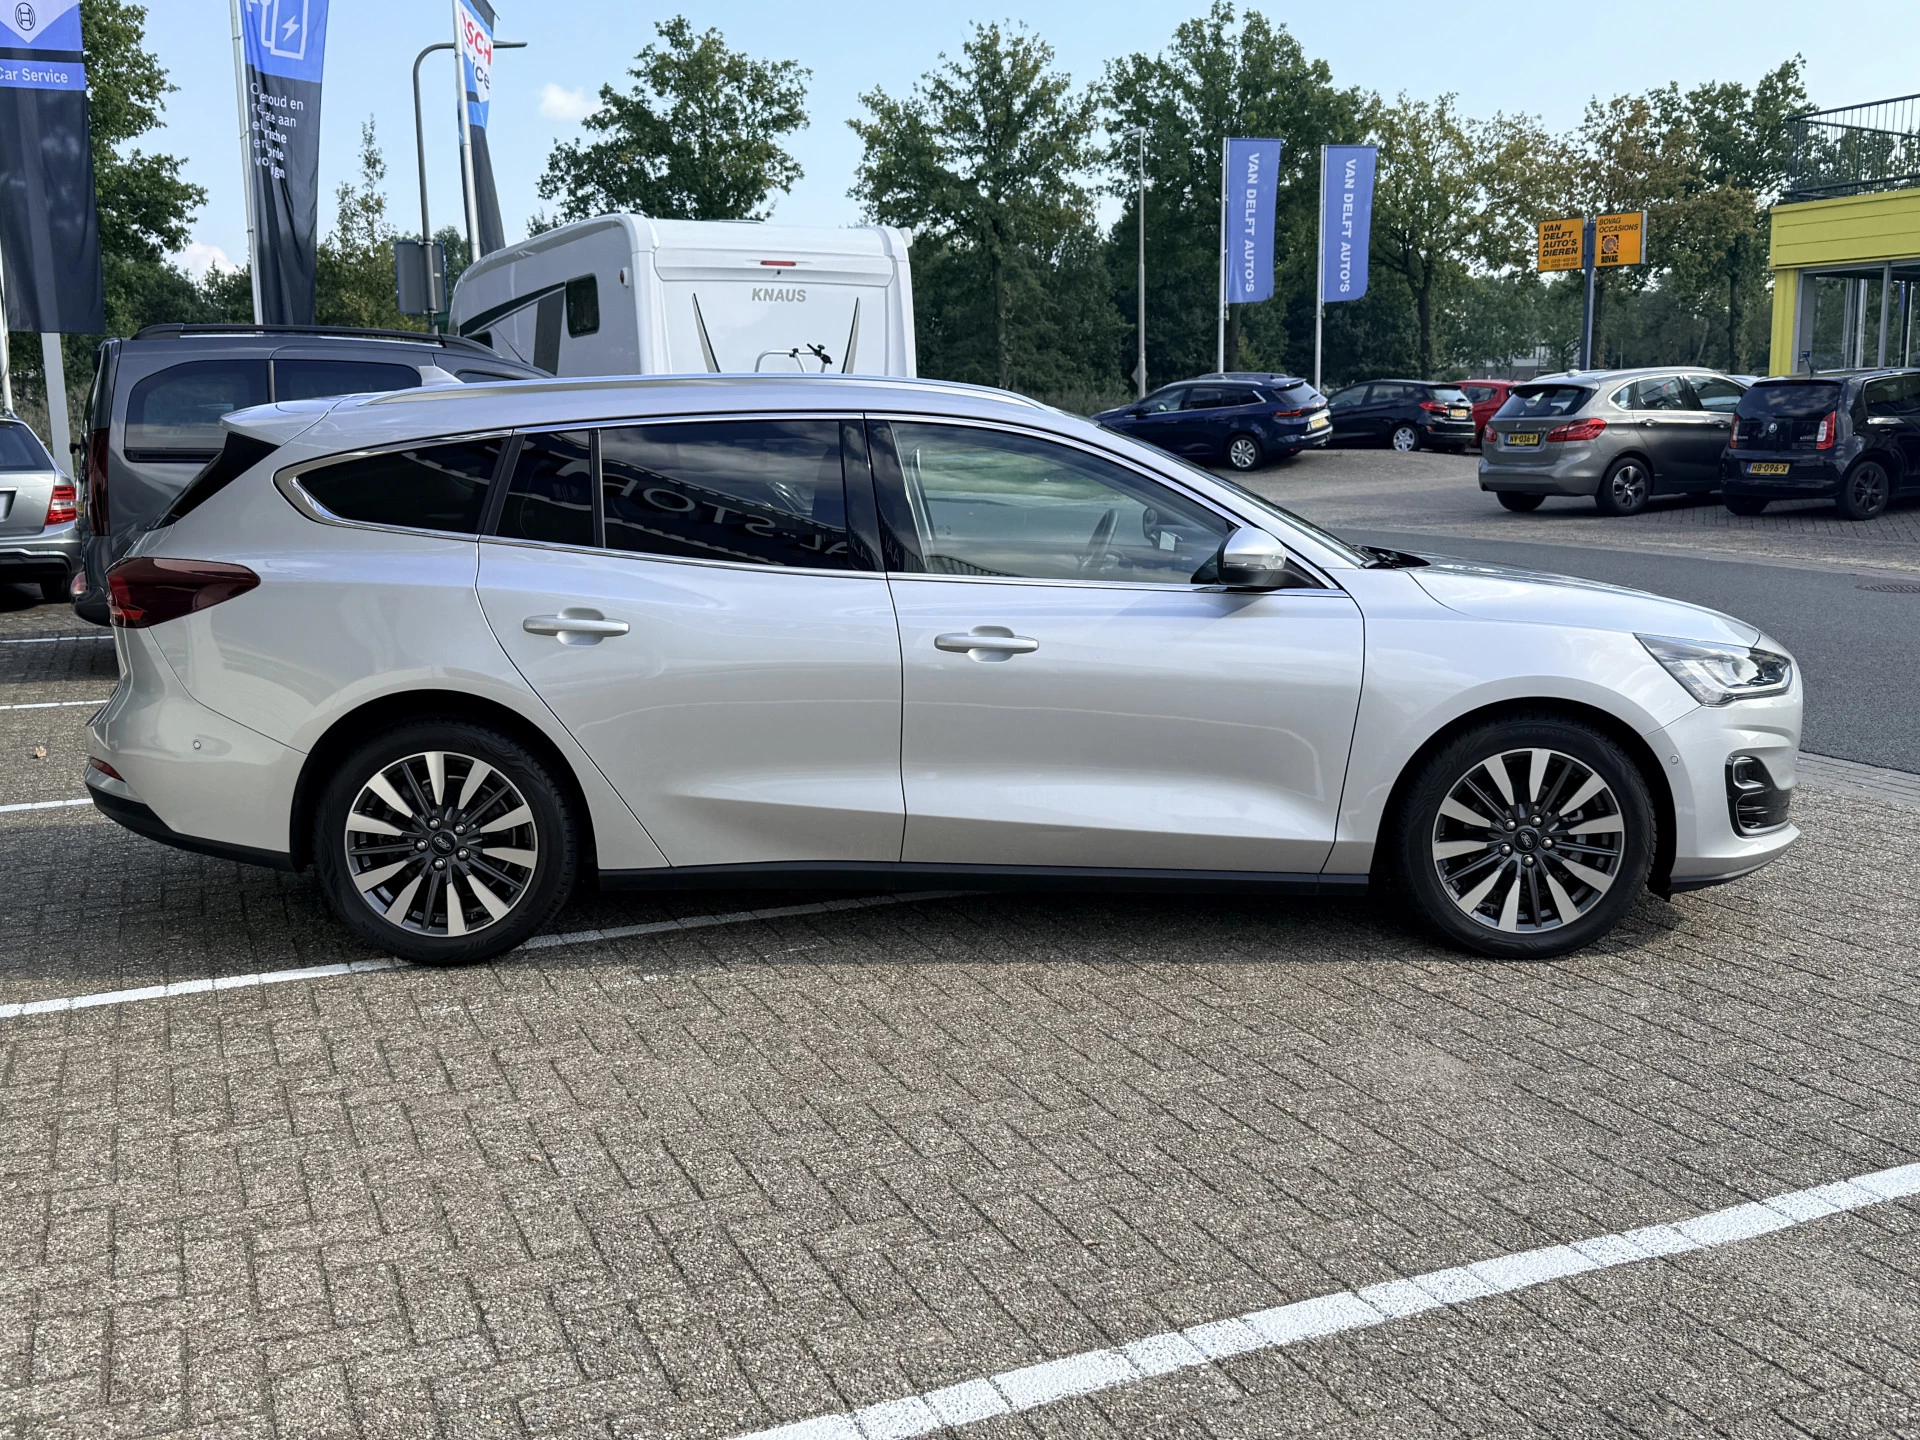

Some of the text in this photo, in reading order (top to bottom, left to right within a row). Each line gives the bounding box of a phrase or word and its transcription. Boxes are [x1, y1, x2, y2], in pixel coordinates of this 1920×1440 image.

[22, 67, 69, 84] Service
[290, 99, 304, 111] en
[278, 115, 296, 128] aan
[1244, 152, 1260, 293] VAN DELFT AUTO'S
[1340, 159, 1357, 293] VAN DELFT AUTO'S
[1543, 224, 1562, 232] VAN
[1599, 224, 1639, 233] OCCASIONS
[1543, 231, 1574, 240] DELFT
[1543, 239, 1577, 249] AUTO'S
[1543, 247, 1578, 257] DIEREN
[751, 287, 807, 303] KNAUS
